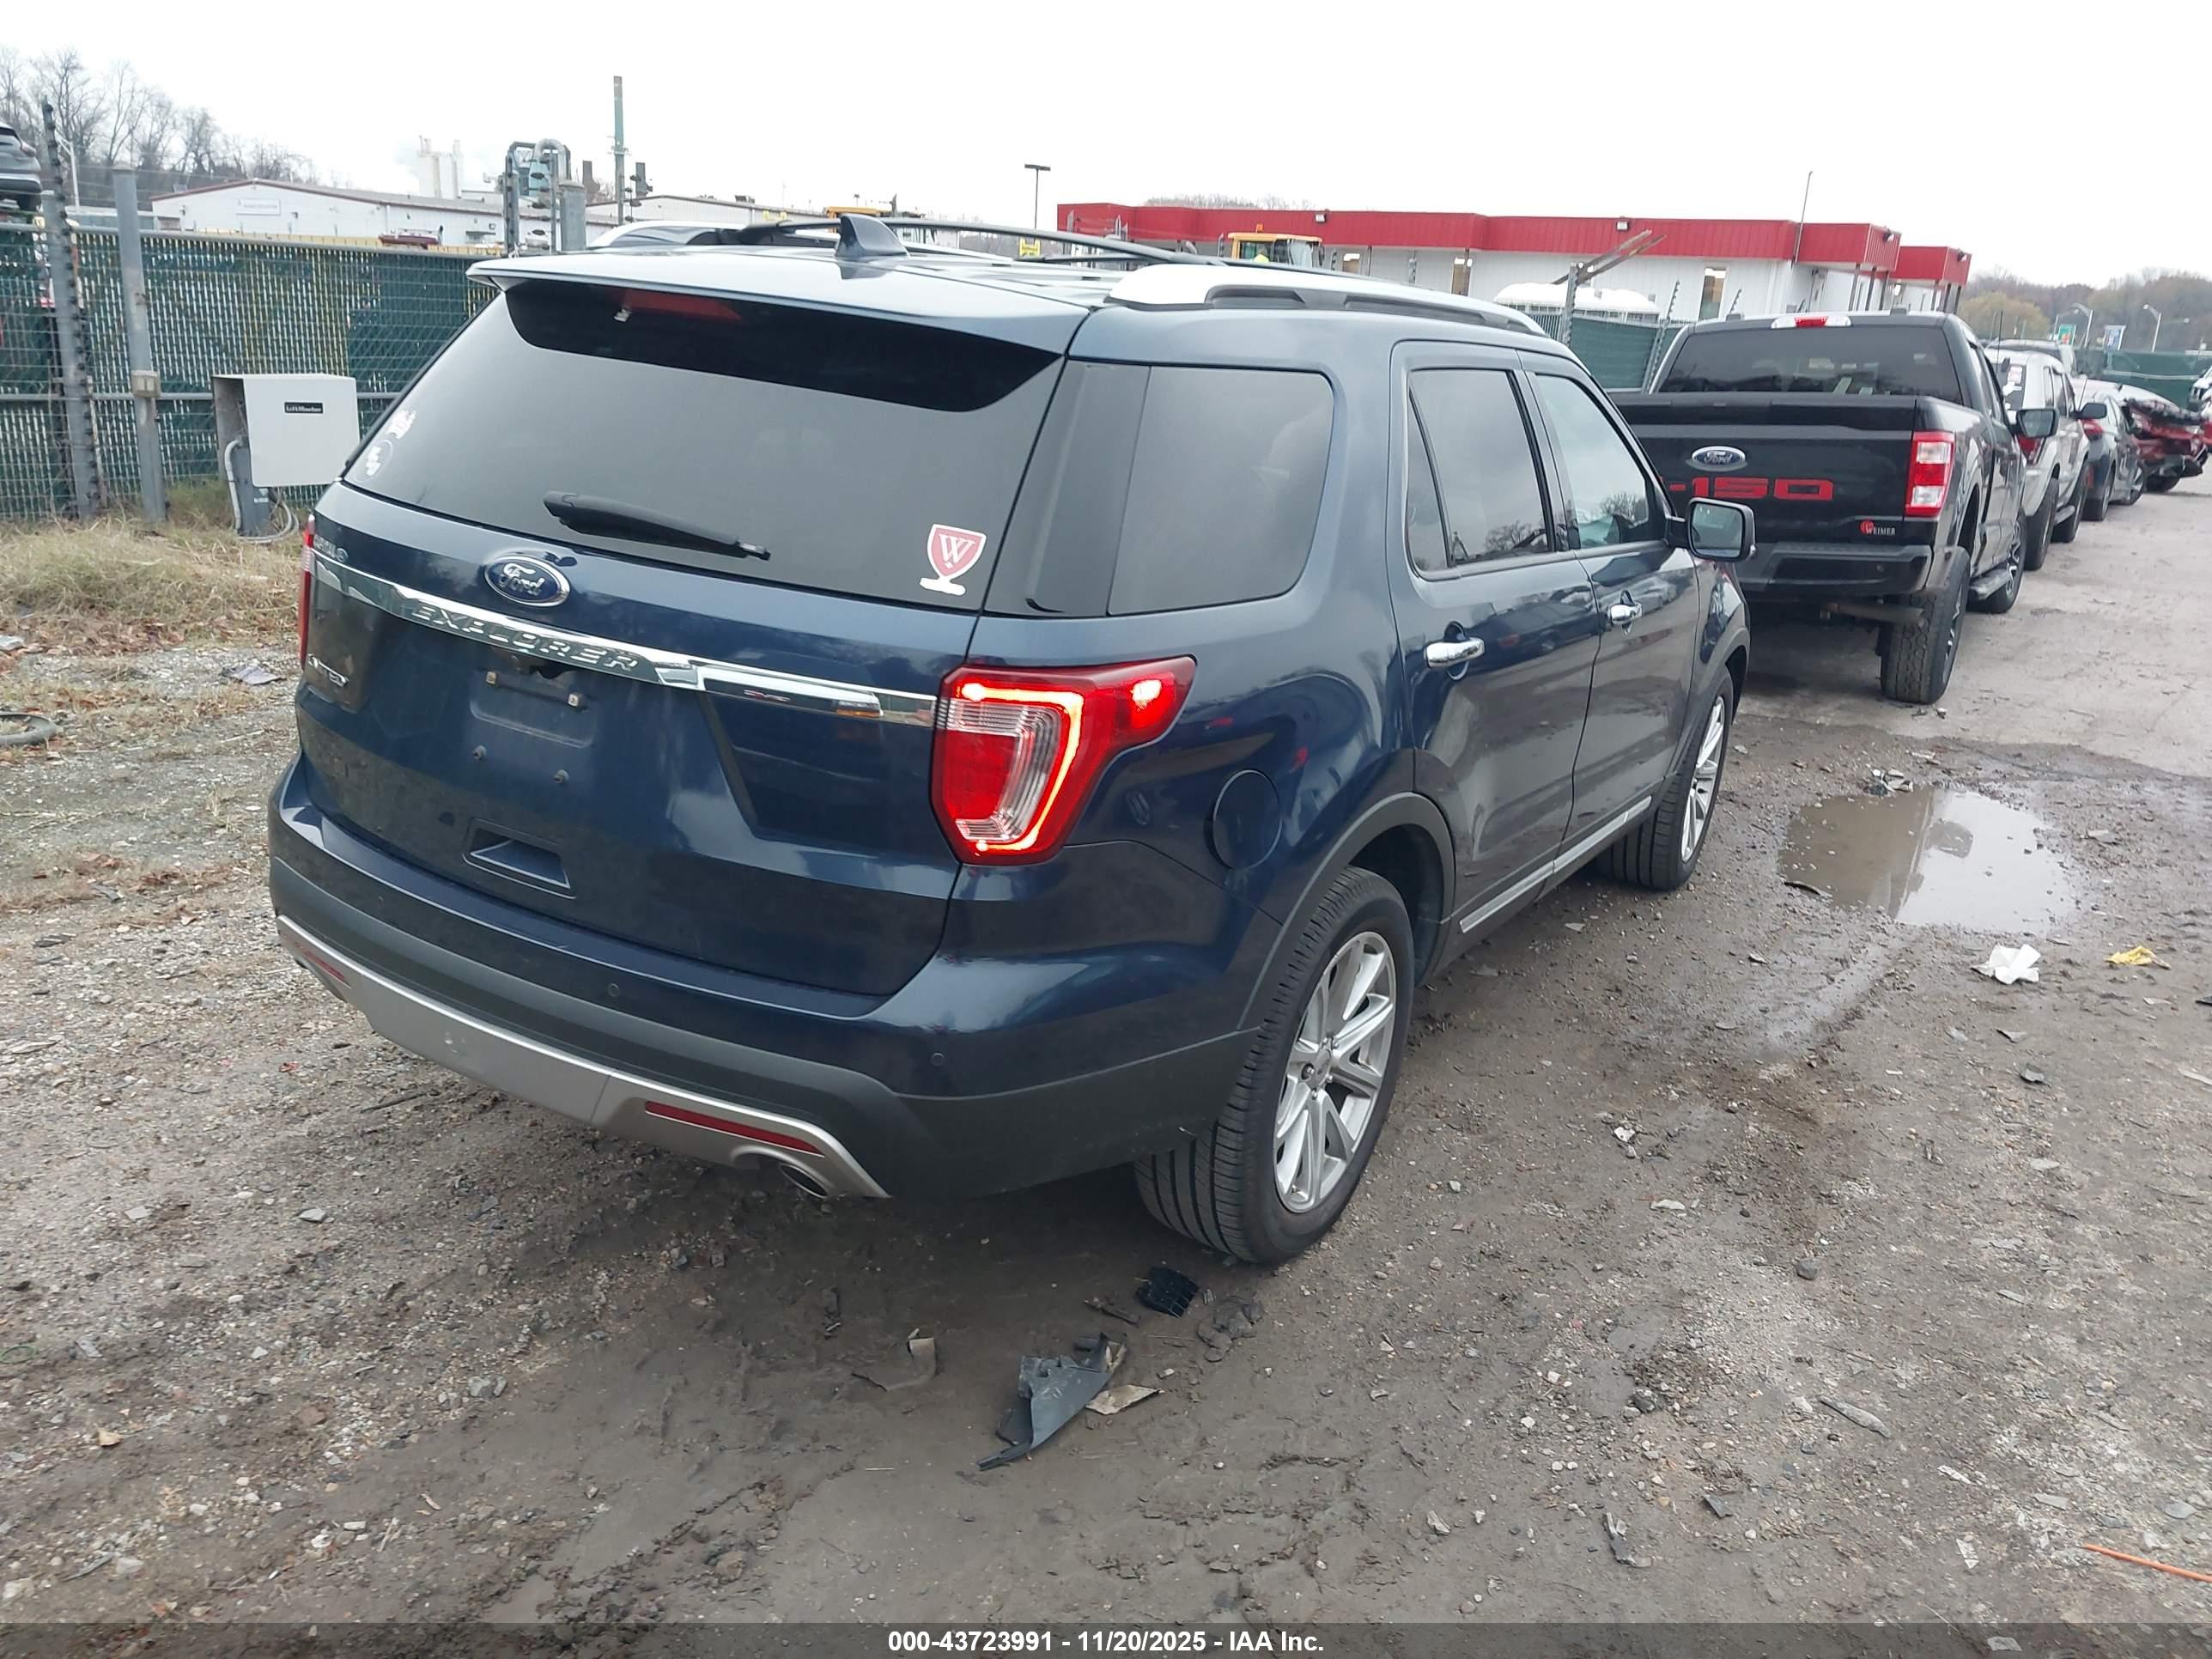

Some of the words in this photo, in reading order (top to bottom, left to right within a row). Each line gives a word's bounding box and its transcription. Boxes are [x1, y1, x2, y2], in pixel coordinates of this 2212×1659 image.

[1704, 450, 1734, 465] Ford
[1659, 477, 1833, 501] -150
[939, 532, 976, 564] W
[497, 562, 546, 597] Ford
[411, 605, 638, 672] EXPLORER
